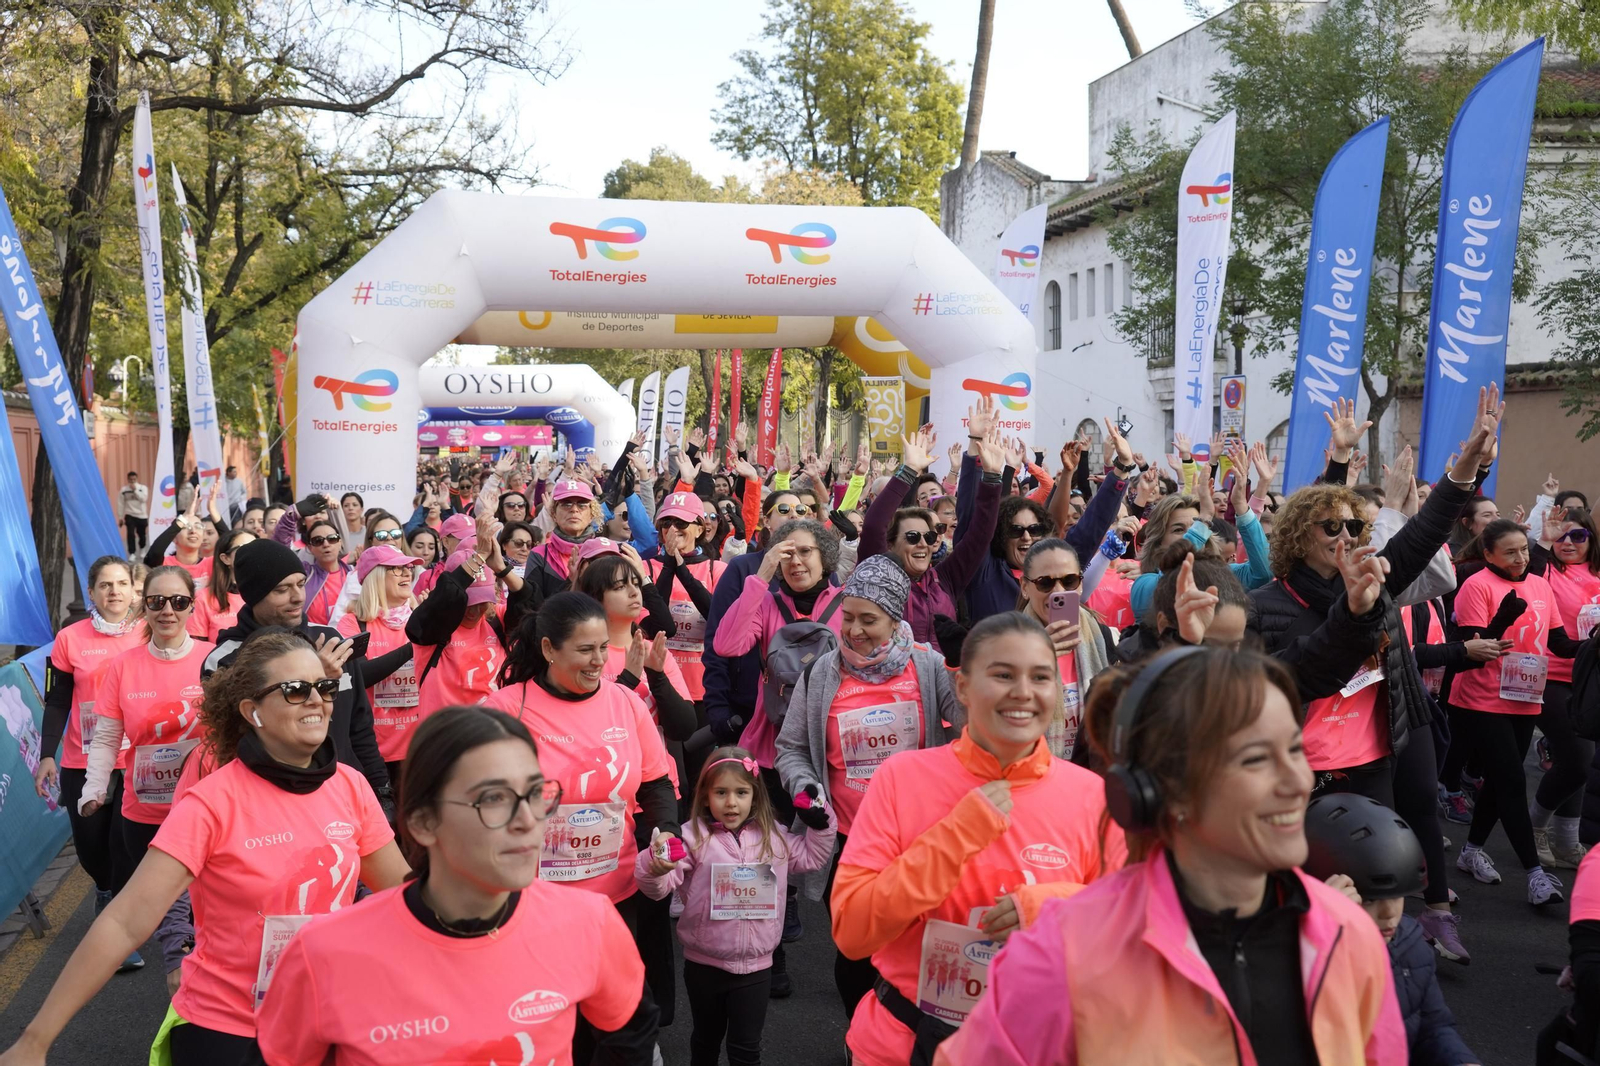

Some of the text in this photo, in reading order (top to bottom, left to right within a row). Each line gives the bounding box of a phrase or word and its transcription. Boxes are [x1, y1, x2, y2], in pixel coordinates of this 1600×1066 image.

[1187, 212, 1229, 223] TotalEnergi
[549, 269, 647, 284] TotalEnergies
[746, 273, 837, 288] TotalEnergies
[1000, 271, 1036, 280] TotalEnergie
[1437, 194, 1504, 383] Marlene
[376, 293, 455, 309] LasCarreras
[936, 305, 1002, 316] LasCarreras
[611, 313, 660, 322] Municipal
[582, 323, 644, 333] de Deportes
[1303, 247, 1362, 408] Marlene
[444, 373, 553, 395] OYSHO
[312, 419, 398, 434] TotalEnergies
[961, 418, 1032, 431] Tonergies
[311, 481, 396, 493] totalenergies.es
[567, 480, 578, 491] R
[671, 494, 687, 507] M
[394, 676, 416, 686] 016
[1346, 675, 1370, 692] OYSHO
[1521, 673, 1538, 682] 016
[127, 691, 157, 700] OYSHO
[539, 734, 575, 745] OYSHO
[868, 734, 898, 748] 016
[155, 768, 180, 780] 016
[845, 778, 869, 793] CARRER
[245, 831, 294, 850] OYSHO
[570, 835, 602, 849] 016
[734, 887, 757, 897] 016
[934, 943, 960, 954] SUMA
[369, 1016, 450, 1044] OYSHO
